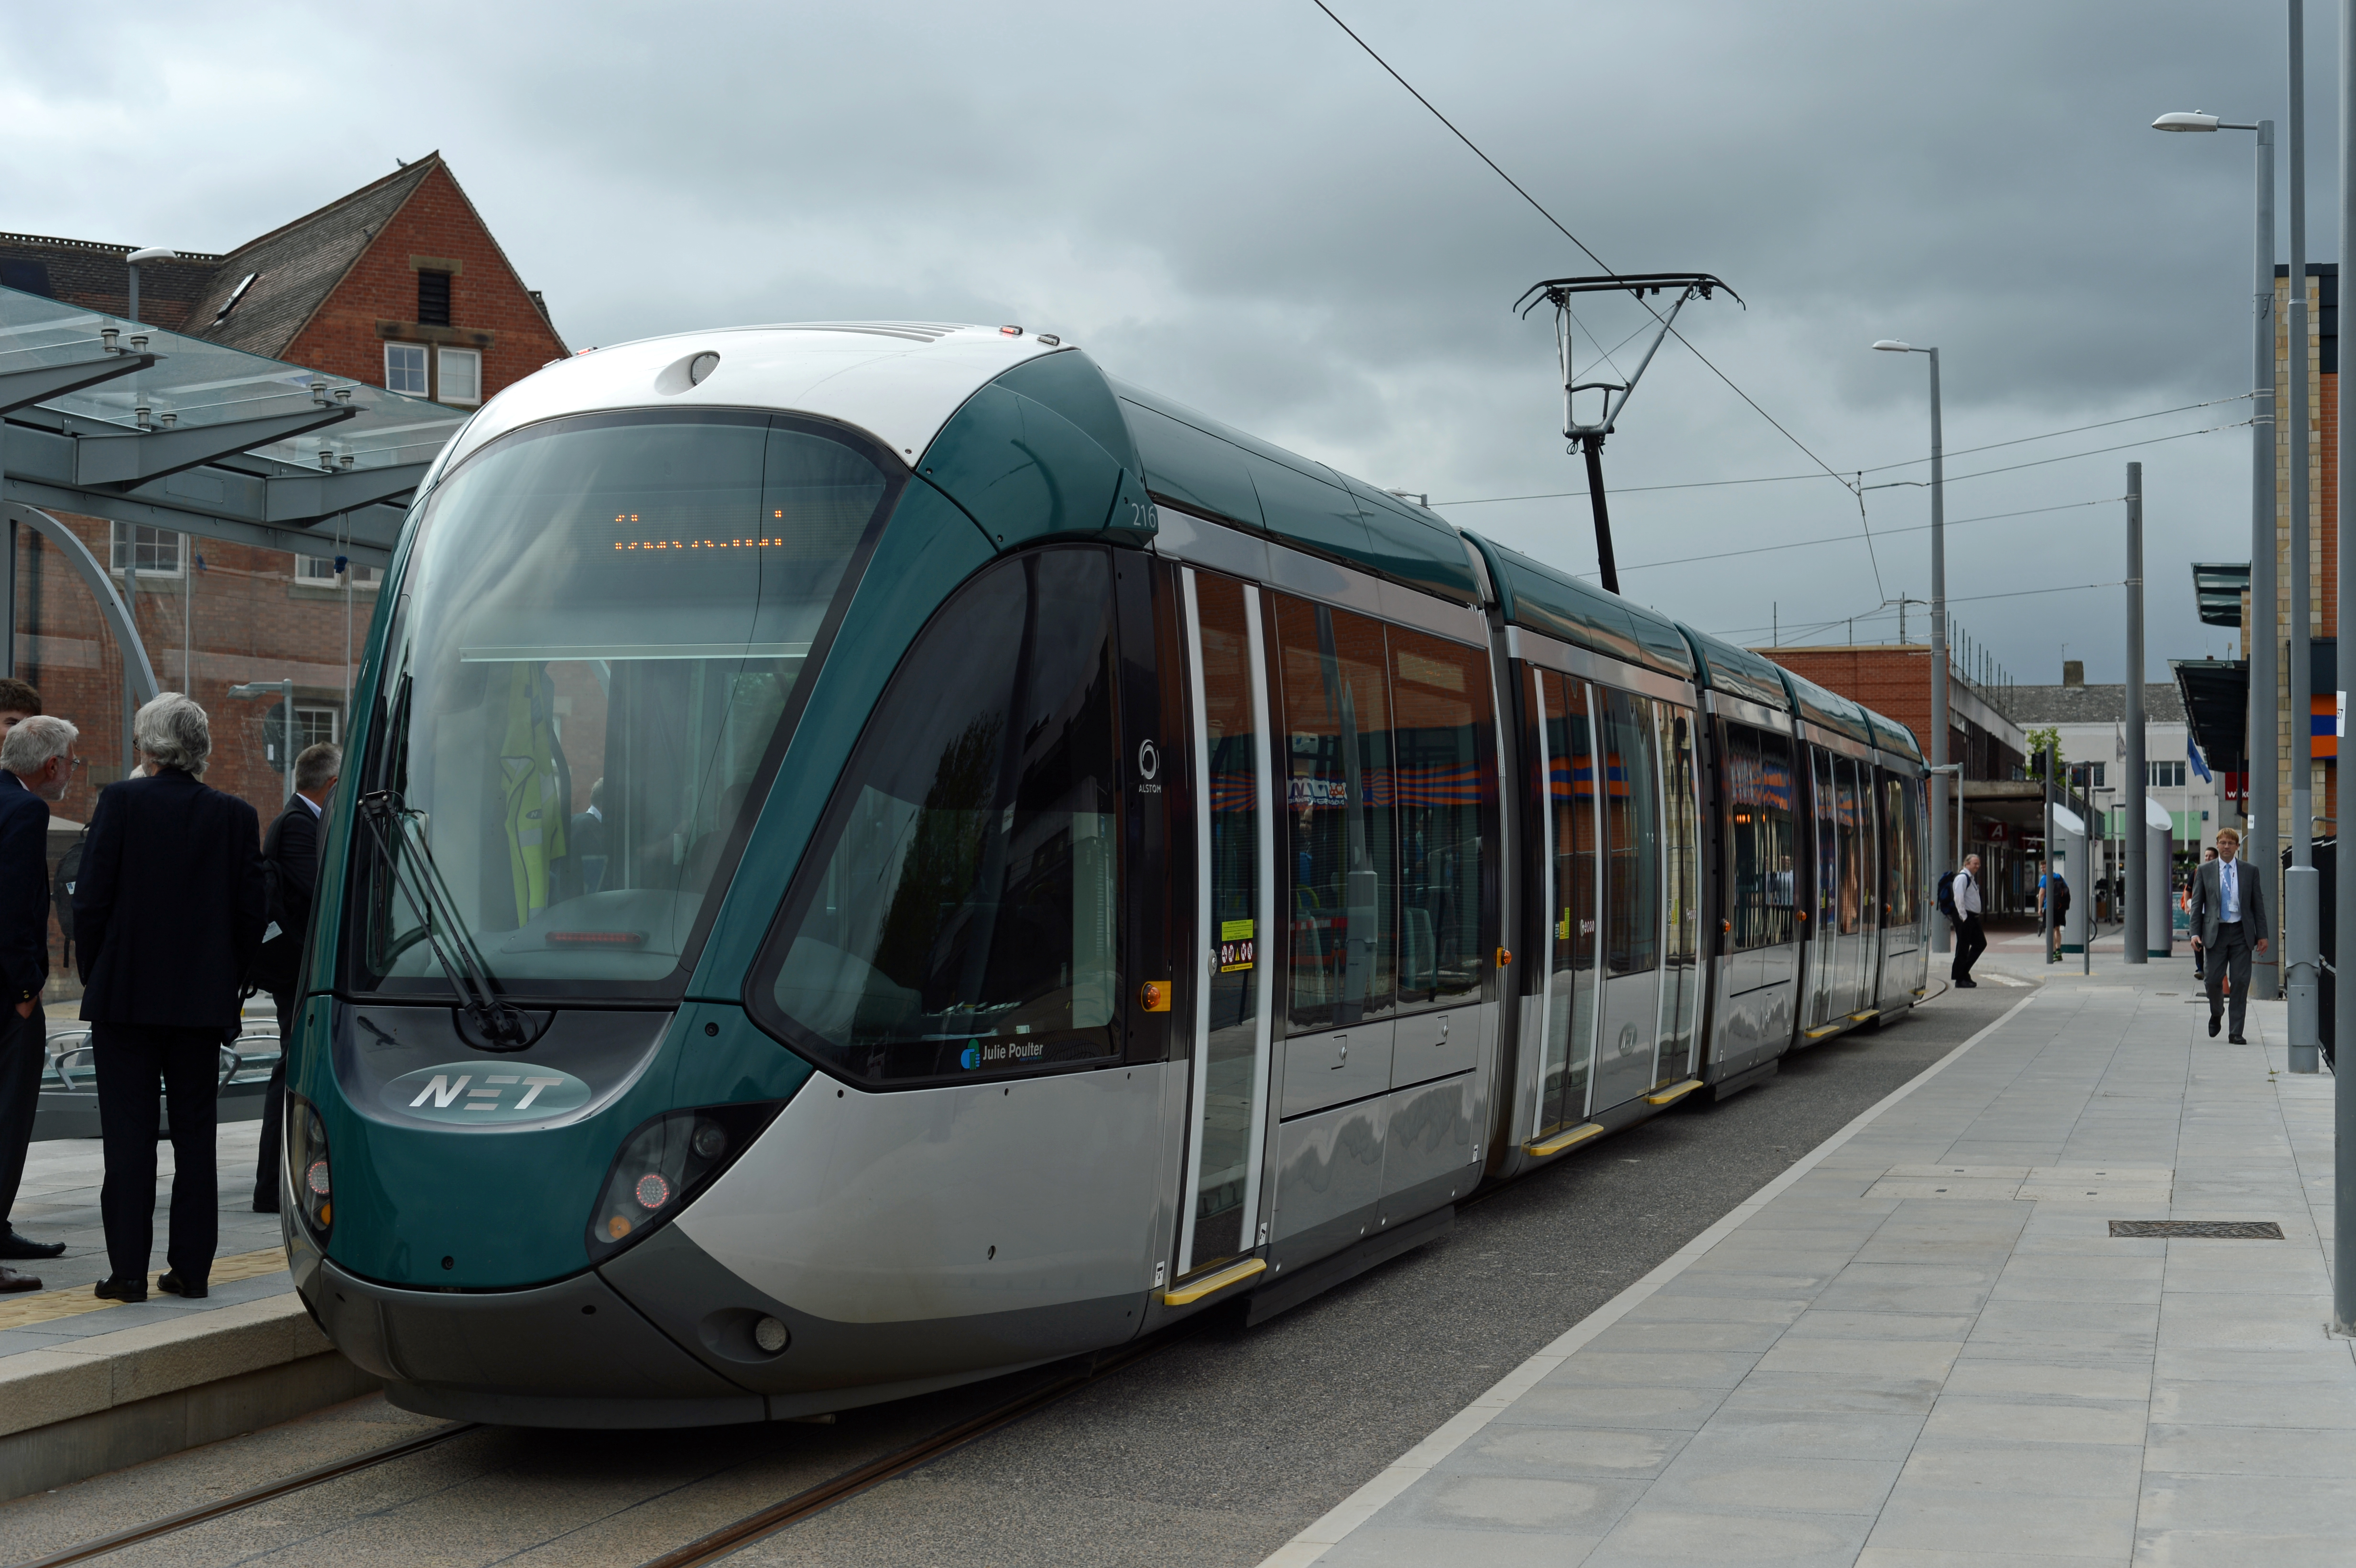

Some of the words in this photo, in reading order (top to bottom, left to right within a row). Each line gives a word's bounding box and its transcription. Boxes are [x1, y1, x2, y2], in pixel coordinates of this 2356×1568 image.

[1132, 503, 1156, 528] 216
[1139, 784, 1161, 793] ALSTOM
[1621, 1028, 1636, 1049] NET
[983, 1045, 1006, 1060] Julie
[1009, 1042, 1043, 1058] Poulter
[408, 1075, 565, 1111] NET
